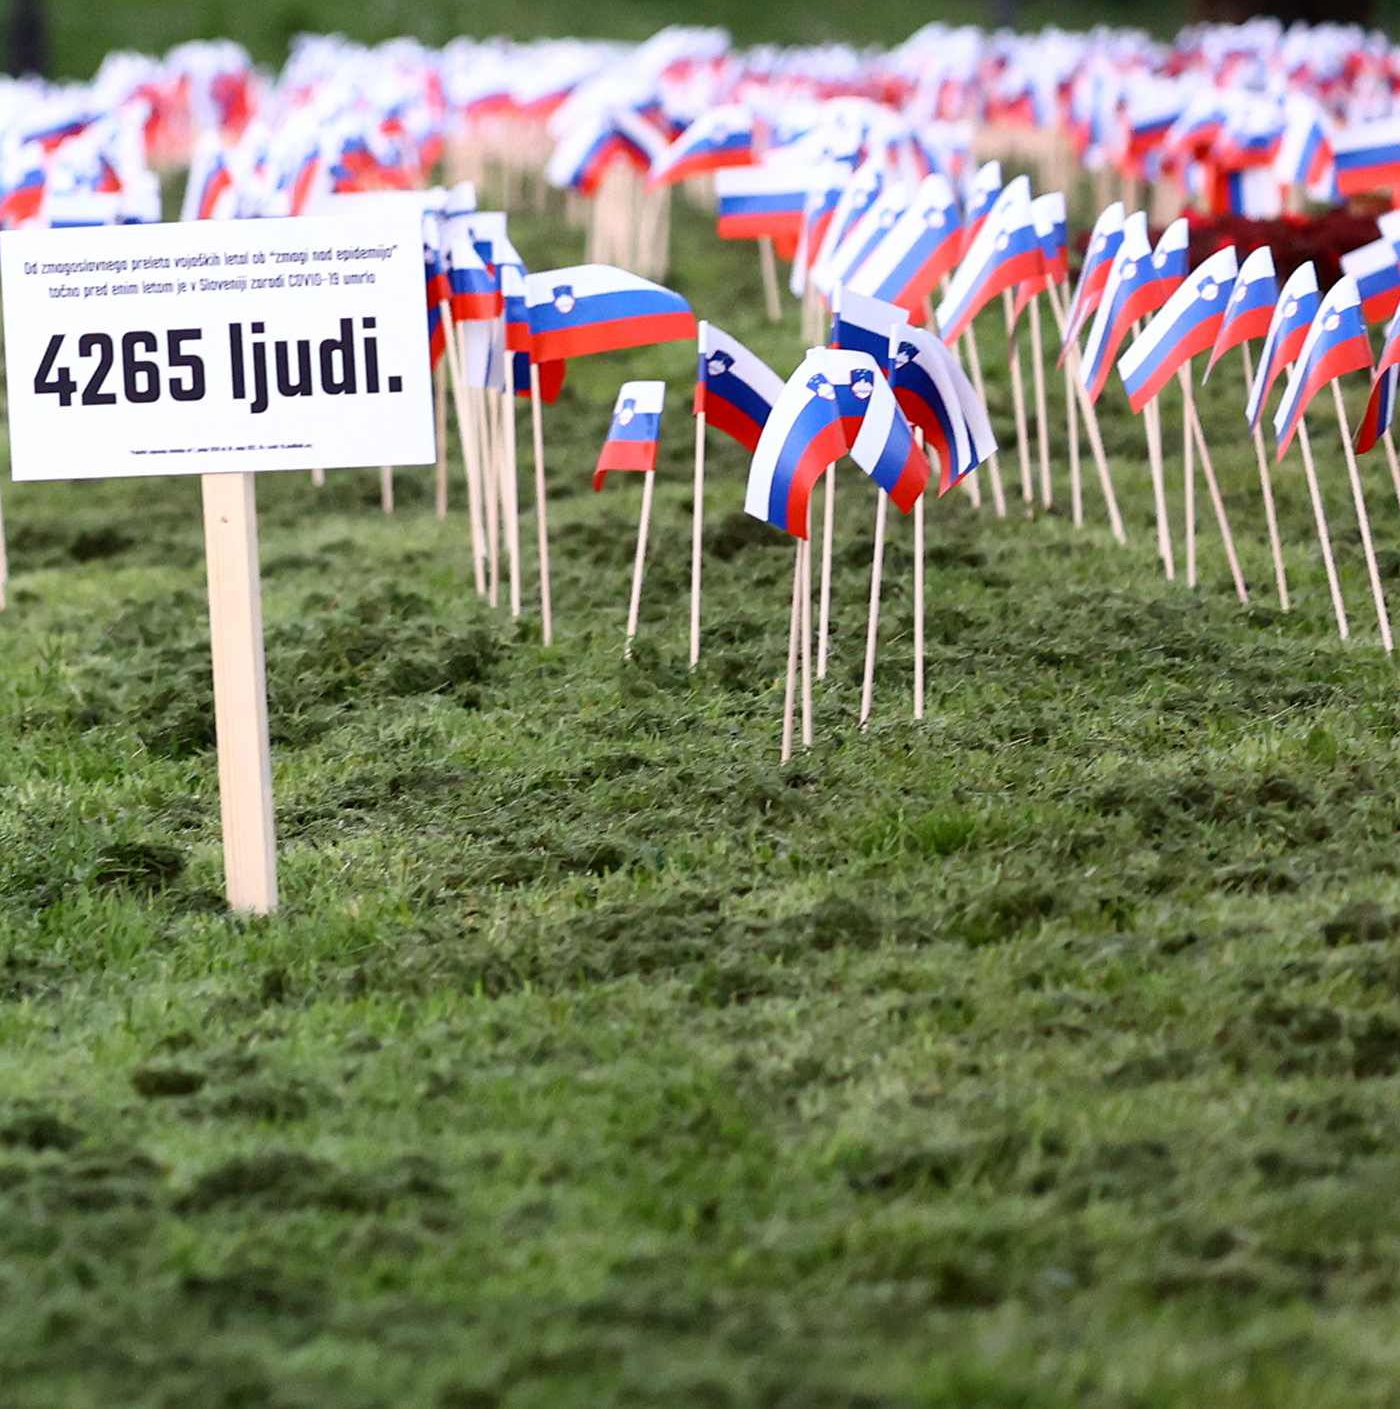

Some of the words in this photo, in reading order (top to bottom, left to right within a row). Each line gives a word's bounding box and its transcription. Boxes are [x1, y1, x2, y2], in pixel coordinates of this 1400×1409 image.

[24, 261, 38, 275] Od
[252, 250, 266, 264] ob
[312, 247, 333, 261] nad
[48, 284, 80, 298] točno
[83, 282, 108, 299] pred
[111, 281, 139, 296] enim
[142, 281, 174, 294] letom
[176, 278, 187, 295] je
[199, 275, 247, 292] Sloveniji
[250, 274, 285, 289] zaradi
[288, 272, 339, 288] COVID-19
[34, 328, 206, 407] 4265
[229, 317, 404, 414] ljudi.
